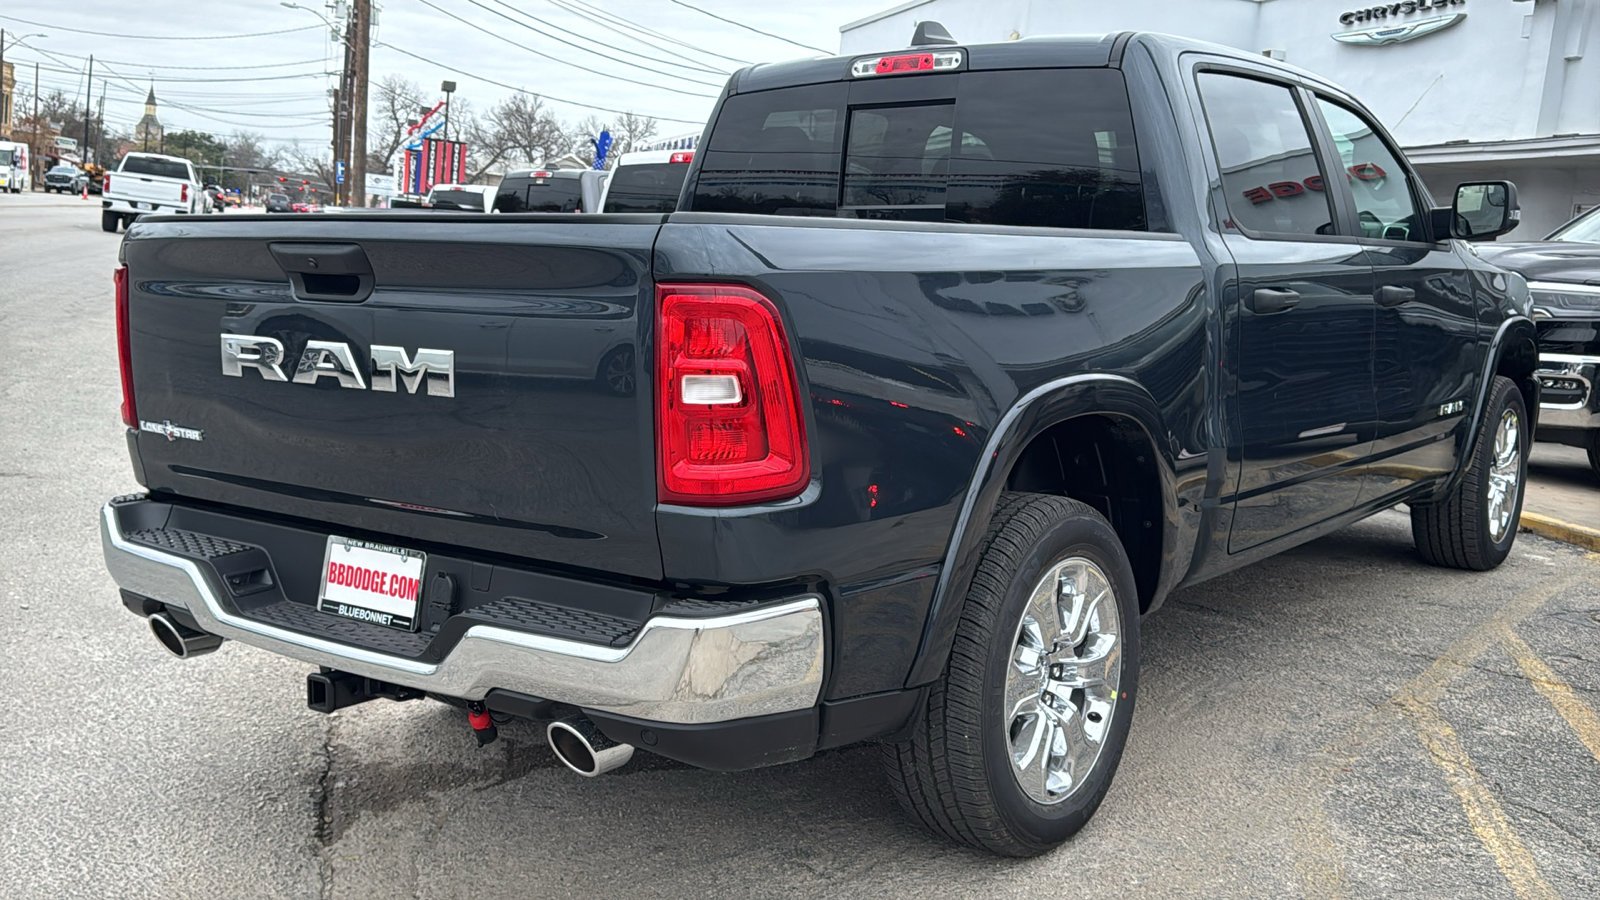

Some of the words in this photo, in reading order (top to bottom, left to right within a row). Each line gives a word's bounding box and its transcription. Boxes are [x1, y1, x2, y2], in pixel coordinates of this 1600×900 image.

[220, 333, 455, 398] RAM
[172, 426, 204, 441] STAR
[347, 539, 364, 548] NEW
[364, 541, 406, 556] BRAUNFELS
[328, 561, 420, 602] BBDODGE.COM
[338, 604, 394, 626] BLUEBONNET
